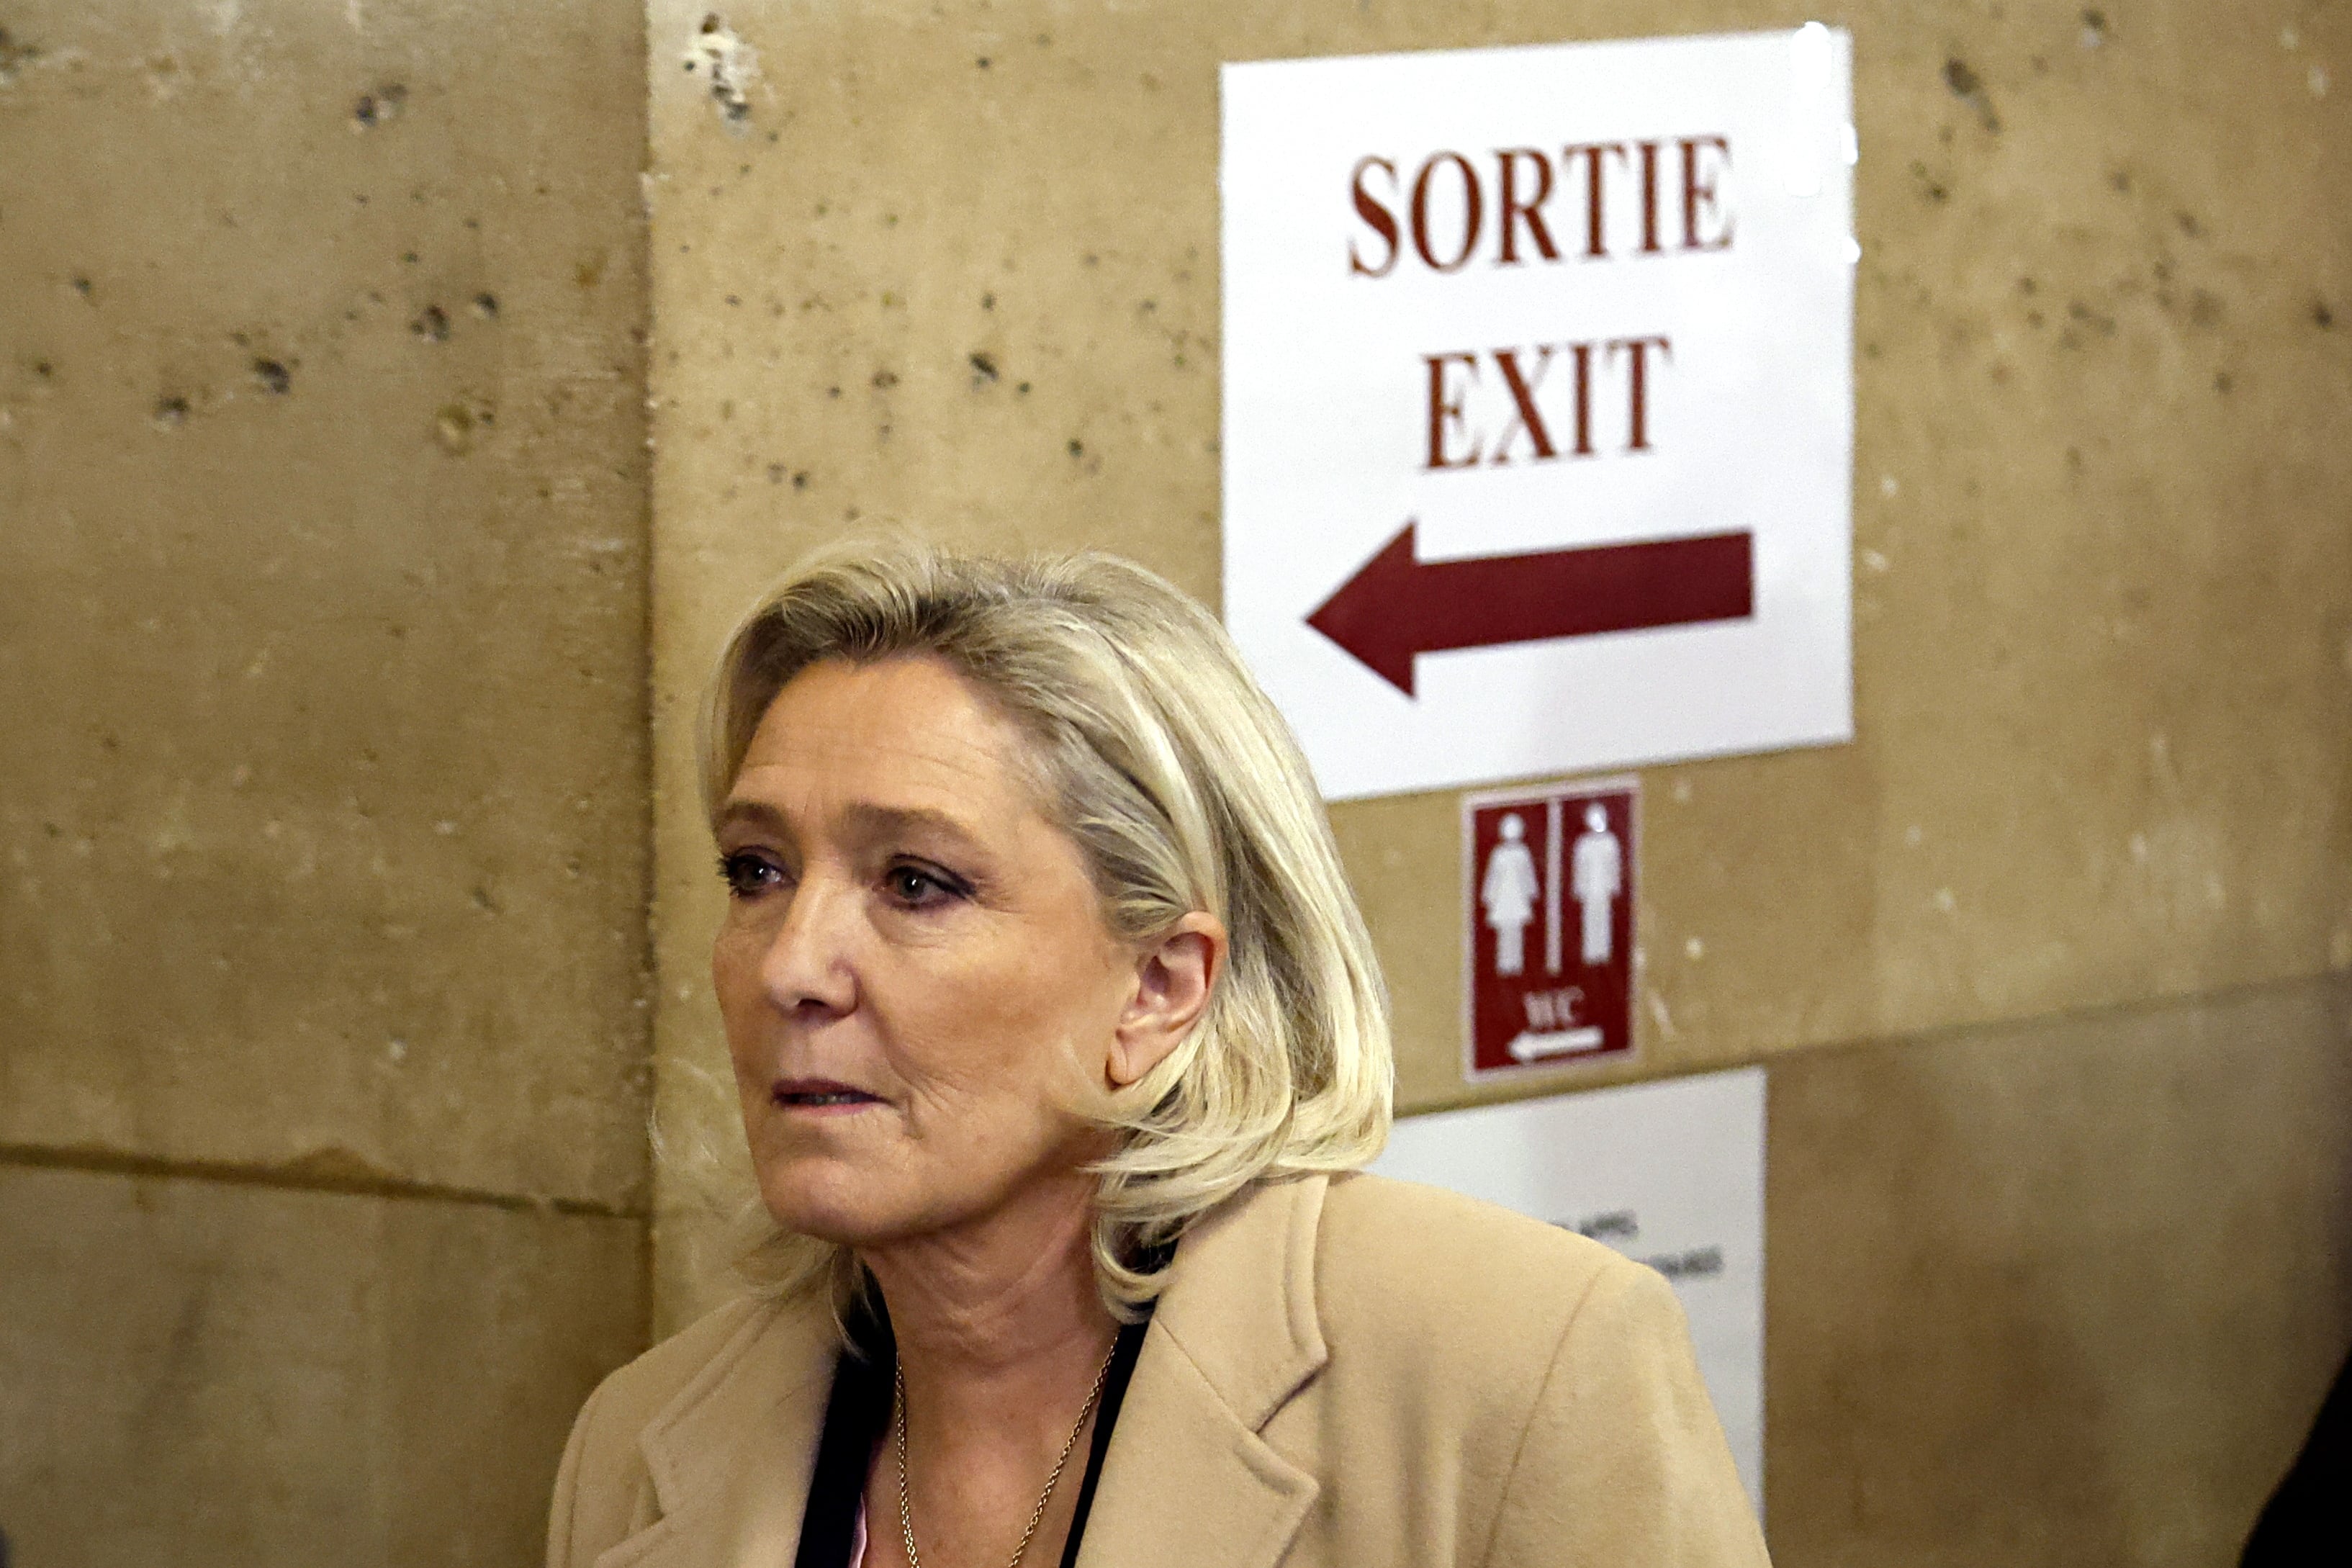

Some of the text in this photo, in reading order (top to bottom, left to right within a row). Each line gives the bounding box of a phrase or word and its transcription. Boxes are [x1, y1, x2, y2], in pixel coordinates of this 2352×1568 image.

[1348, 133, 1732, 277] SORTIE
[1421, 334, 1672, 472] EXIT
[1523, 986, 1585, 1027] WC
